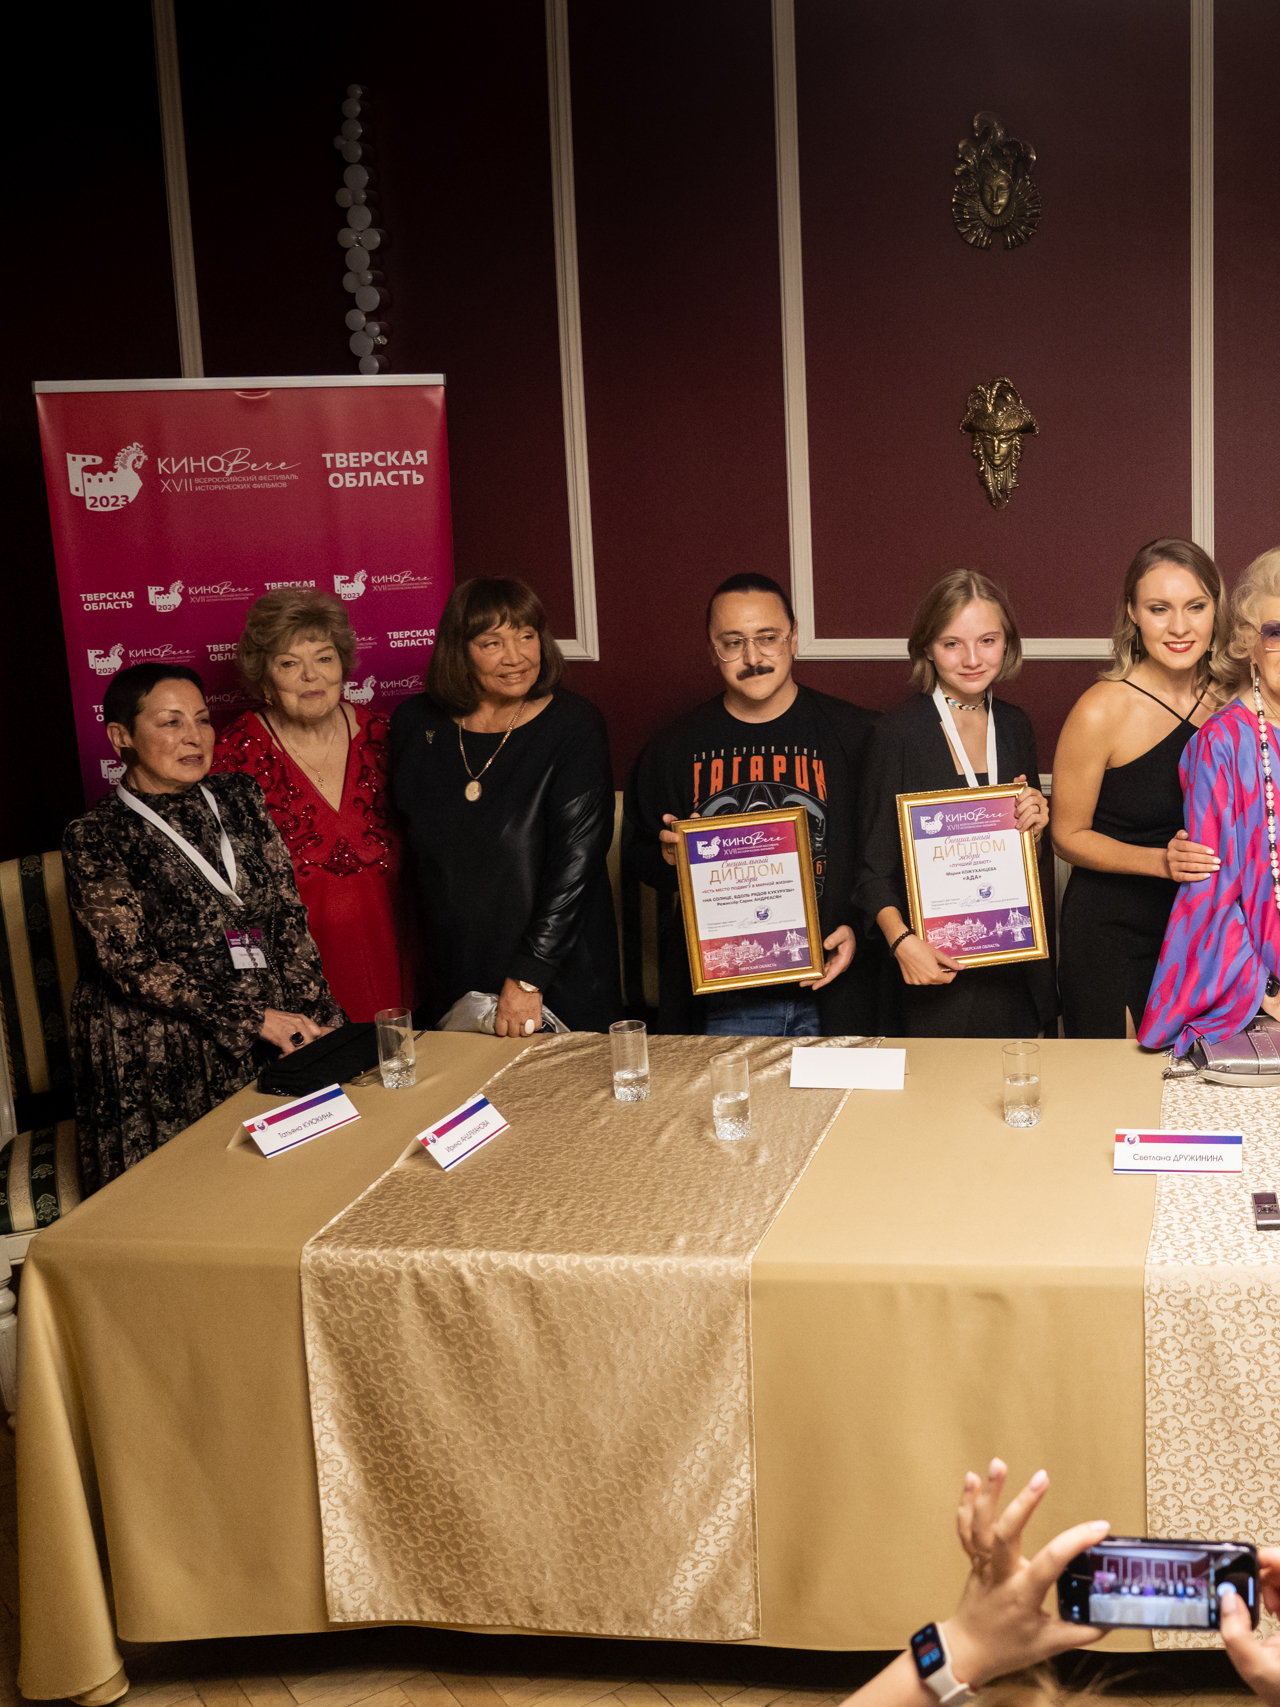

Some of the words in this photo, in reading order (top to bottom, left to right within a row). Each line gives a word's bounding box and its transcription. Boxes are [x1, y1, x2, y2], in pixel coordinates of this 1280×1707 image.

[321, 450, 428, 469] ТВЕРСКАЯ
[194, 475, 257, 484] ВСЕРОССИЙСКИЙ
[258, 473, 299, 481] ФЕСТИВАЛЬ
[328, 471, 424, 489] ОБЛАСТЬ
[160, 478, 193, 493] XVII
[194, 483, 251, 492] ИСТОРИЧЕСКИХ
[252, 482, 288, 490] ФИЛЬМОВ
[89, 494, 130, 509] 2023
[80, 591, 135, 602] ТВЕРСКАЯ
[83, 601, 133, 611] ОБЛАСТЬ
[386, 628, 436, 640] ТВЕРСКАЯ
[206, 643, 238, 653] ТВЕРС
[390, 638, 434, 648] ОБЛАСТЬ
[209, 652, 238, 662] ОБЛА
[932, 839, 1006, 861] ДИПЛОМ
[709, 862, 784, 885] ДИПЛОМ
[278, 1125, 303, 1139] Татьяна
[1132, 1153, 1171, 1162] Светлана
[1173, 1154, 1224, 1163] ДРУЖИНИНА
